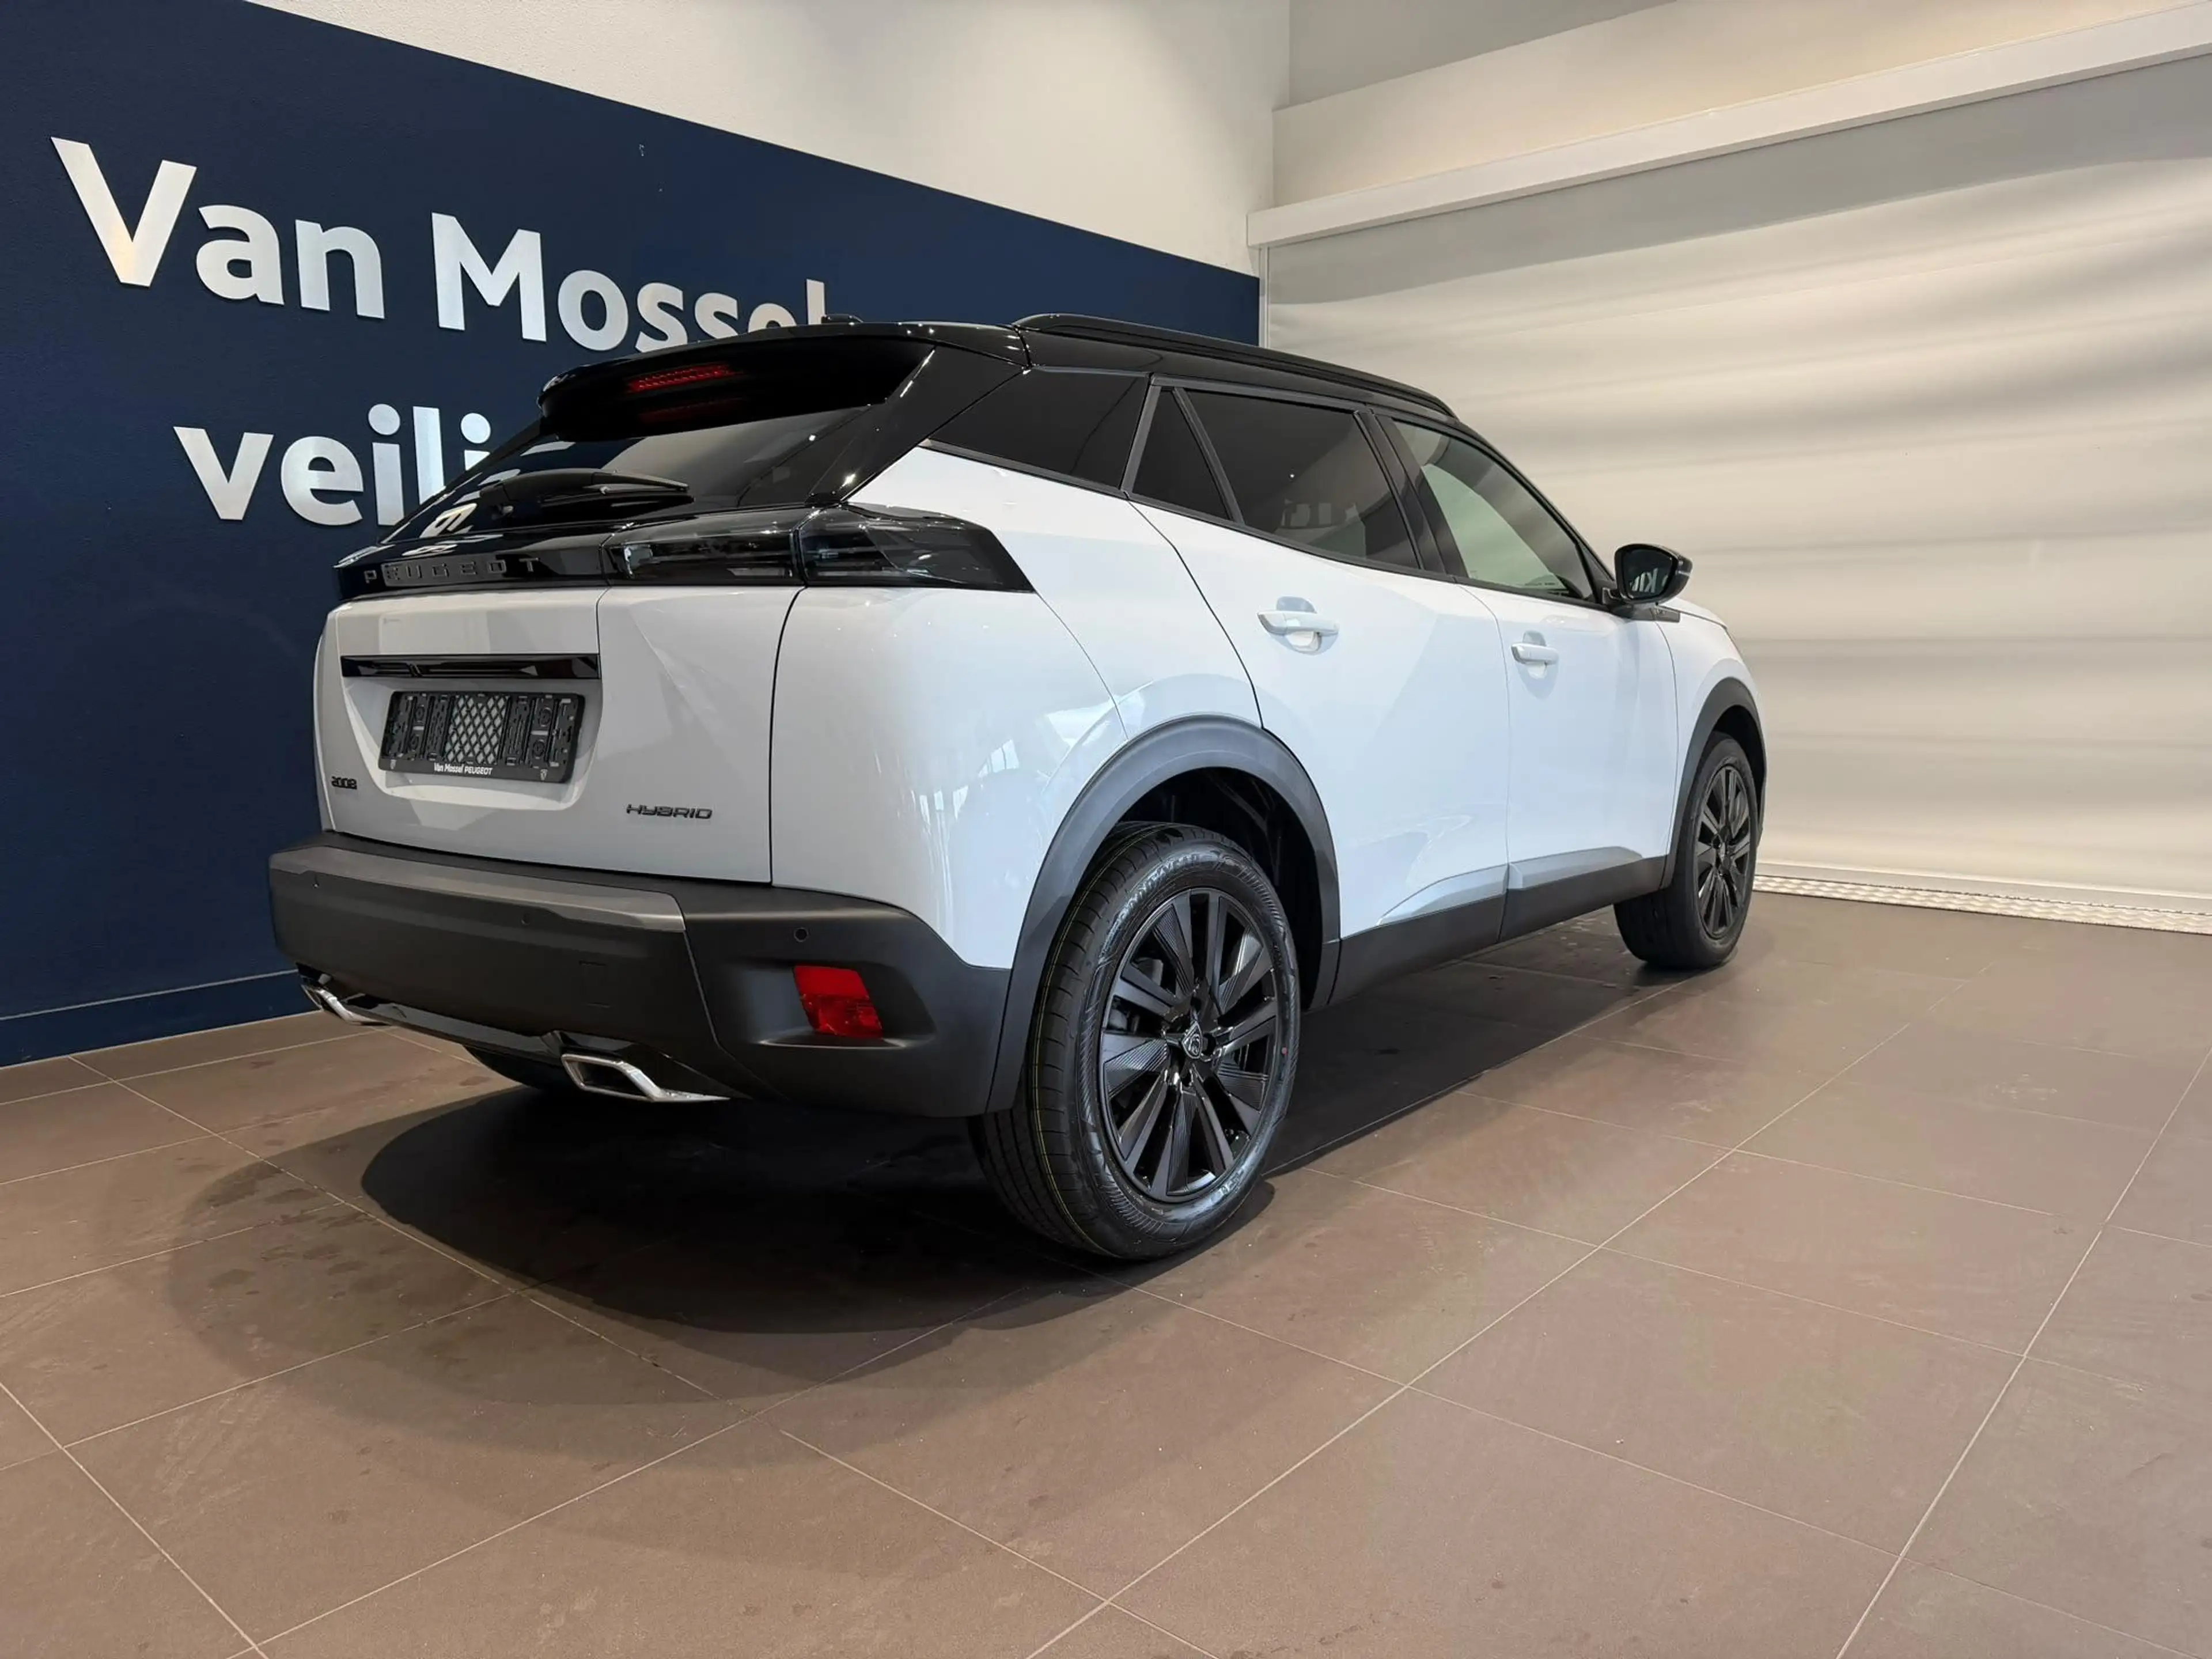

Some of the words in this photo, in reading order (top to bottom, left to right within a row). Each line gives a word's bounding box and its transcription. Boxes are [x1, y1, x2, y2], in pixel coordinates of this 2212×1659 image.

[51, 136, 385, 320] Van
[363, 556, 540, 584] PEUGEOT
[434, 762, 444, 772] Van
[464, 765, 493, 775] PEUGEOT
[331, 776, 357, 790] 2008
[626, 804, 713, 819] HYBRID
